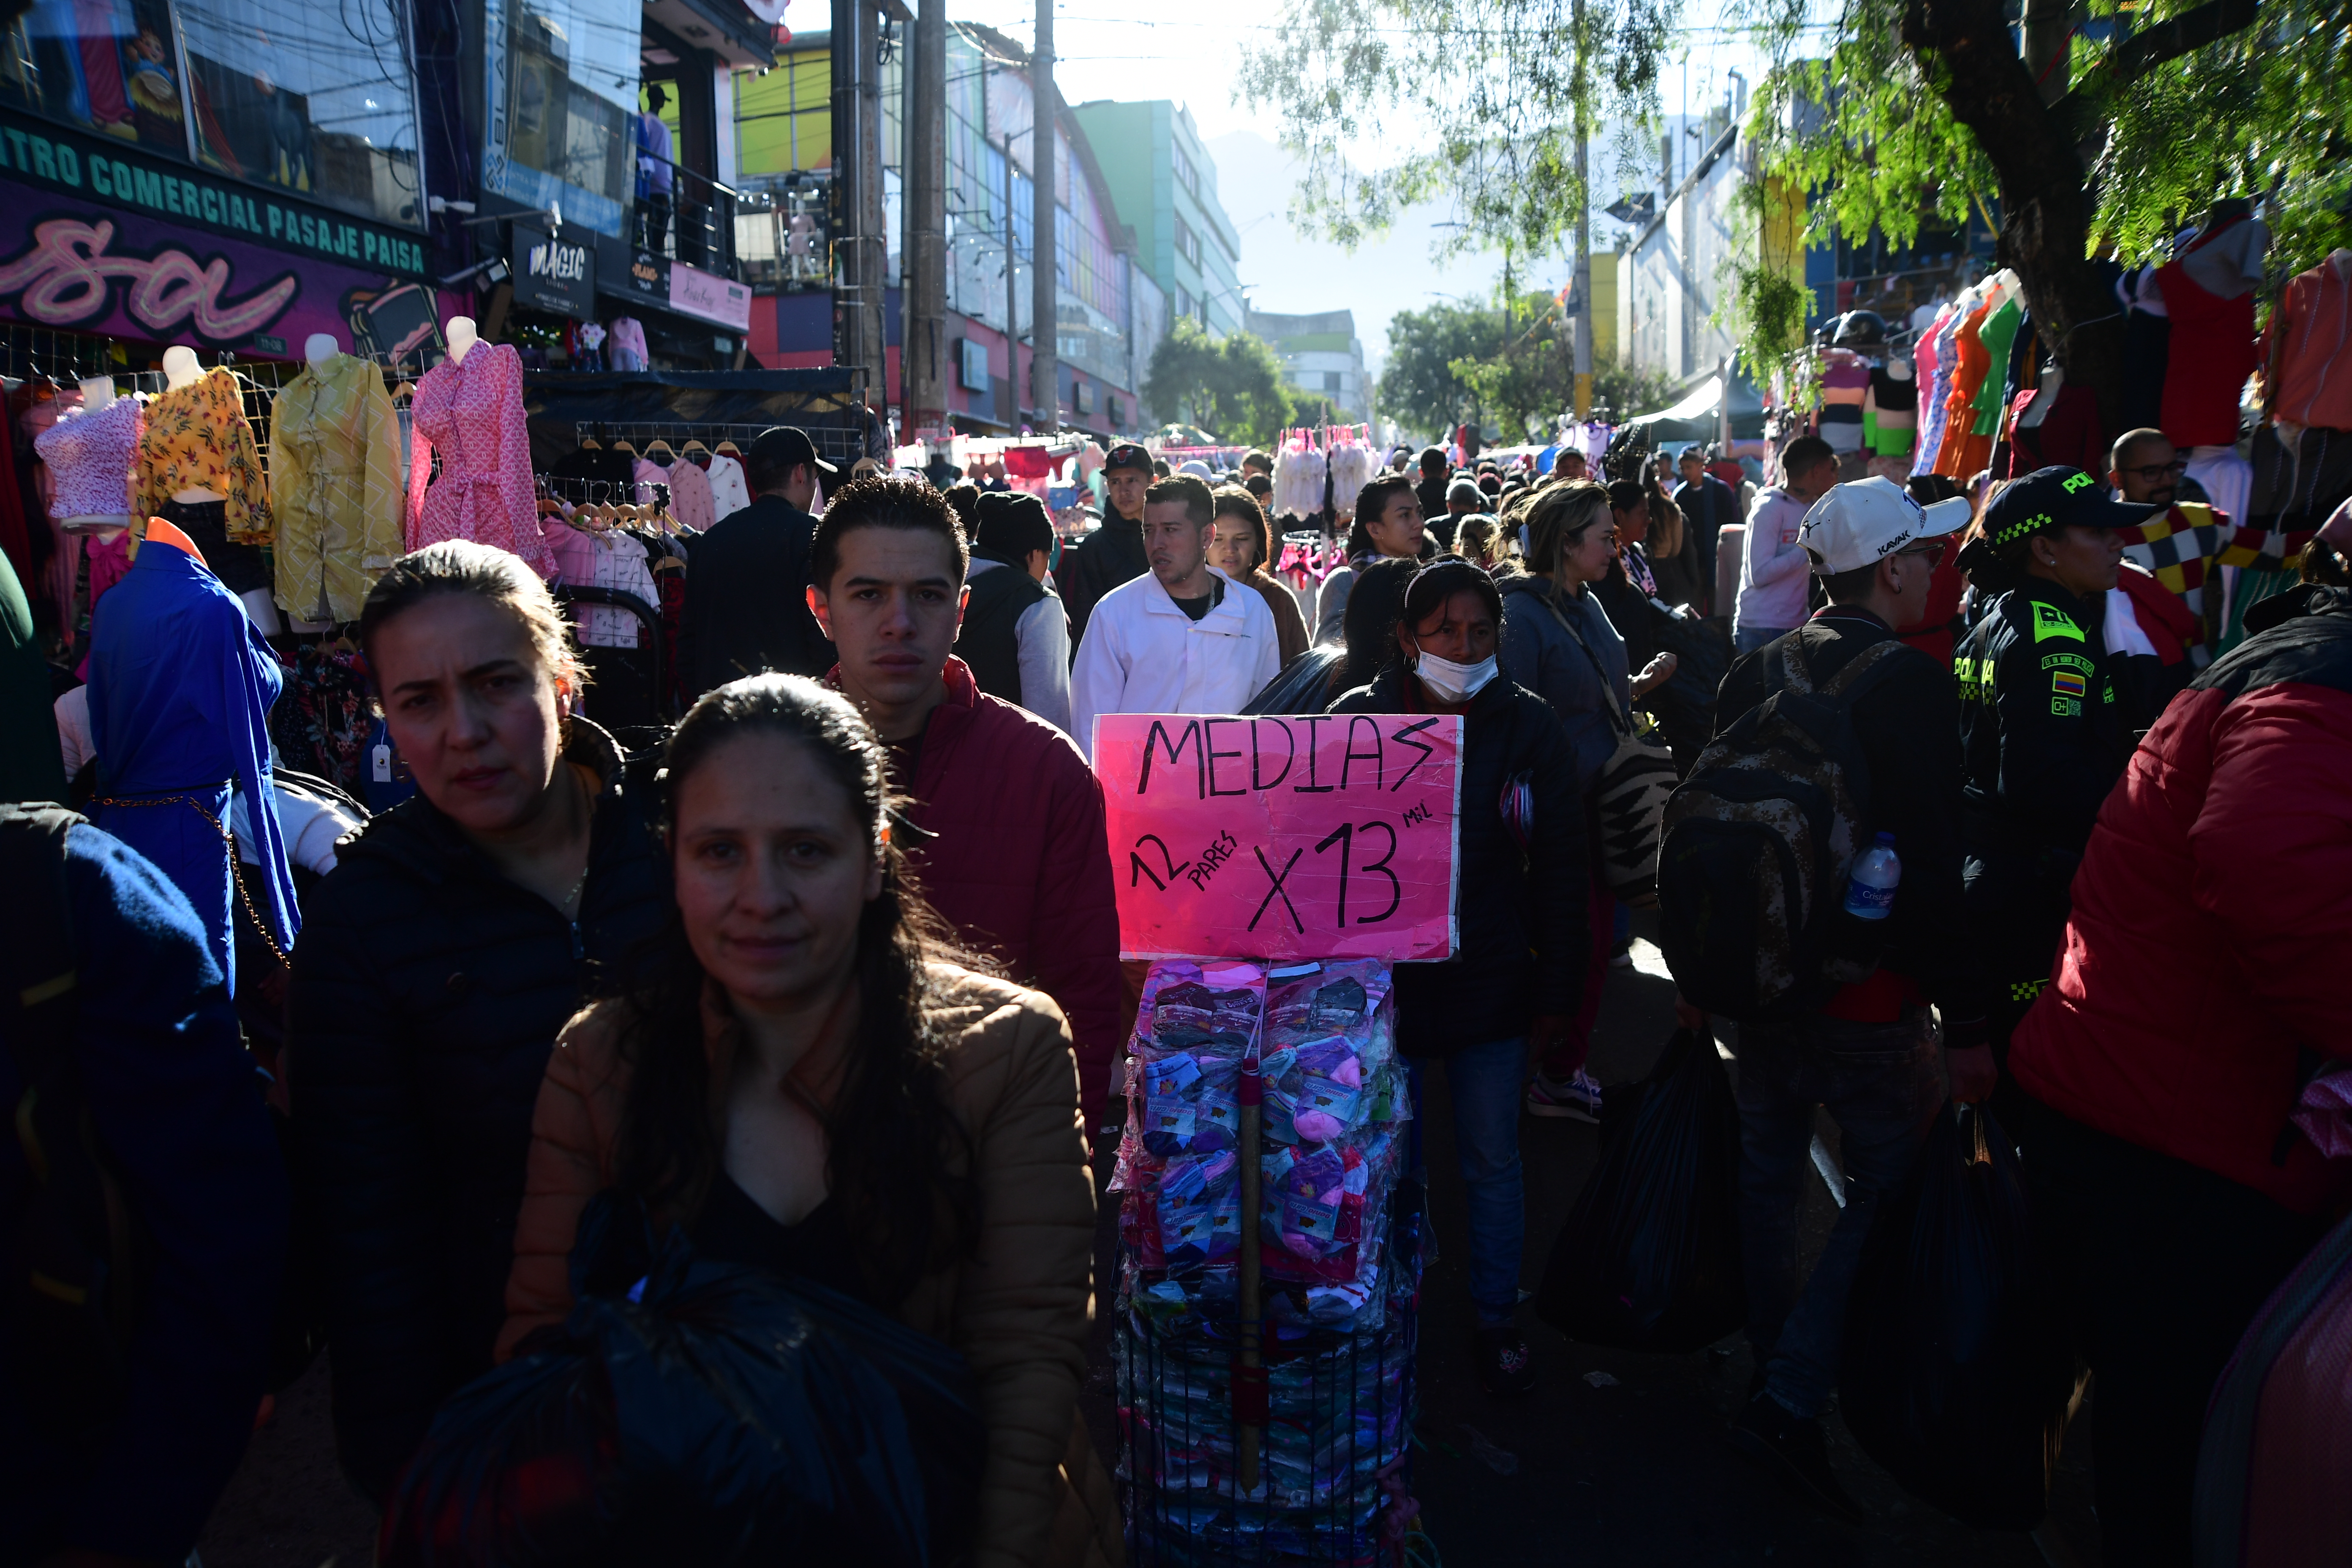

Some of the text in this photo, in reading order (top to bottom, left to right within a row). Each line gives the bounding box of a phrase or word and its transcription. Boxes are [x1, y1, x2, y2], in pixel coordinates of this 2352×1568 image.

[89, 153, 263, 235] COMERCIAL
[267, 203, 359, 259] PASAJE
[363, 230, 426, 274] PAISA
[529, 240, 585, 281] MAGIC
[1878, 530, 1910, 555] KAVAK
[1137, 715, 1440, 800] MEDIAS
[1131, 830, 1238, 892] 12 PARES
